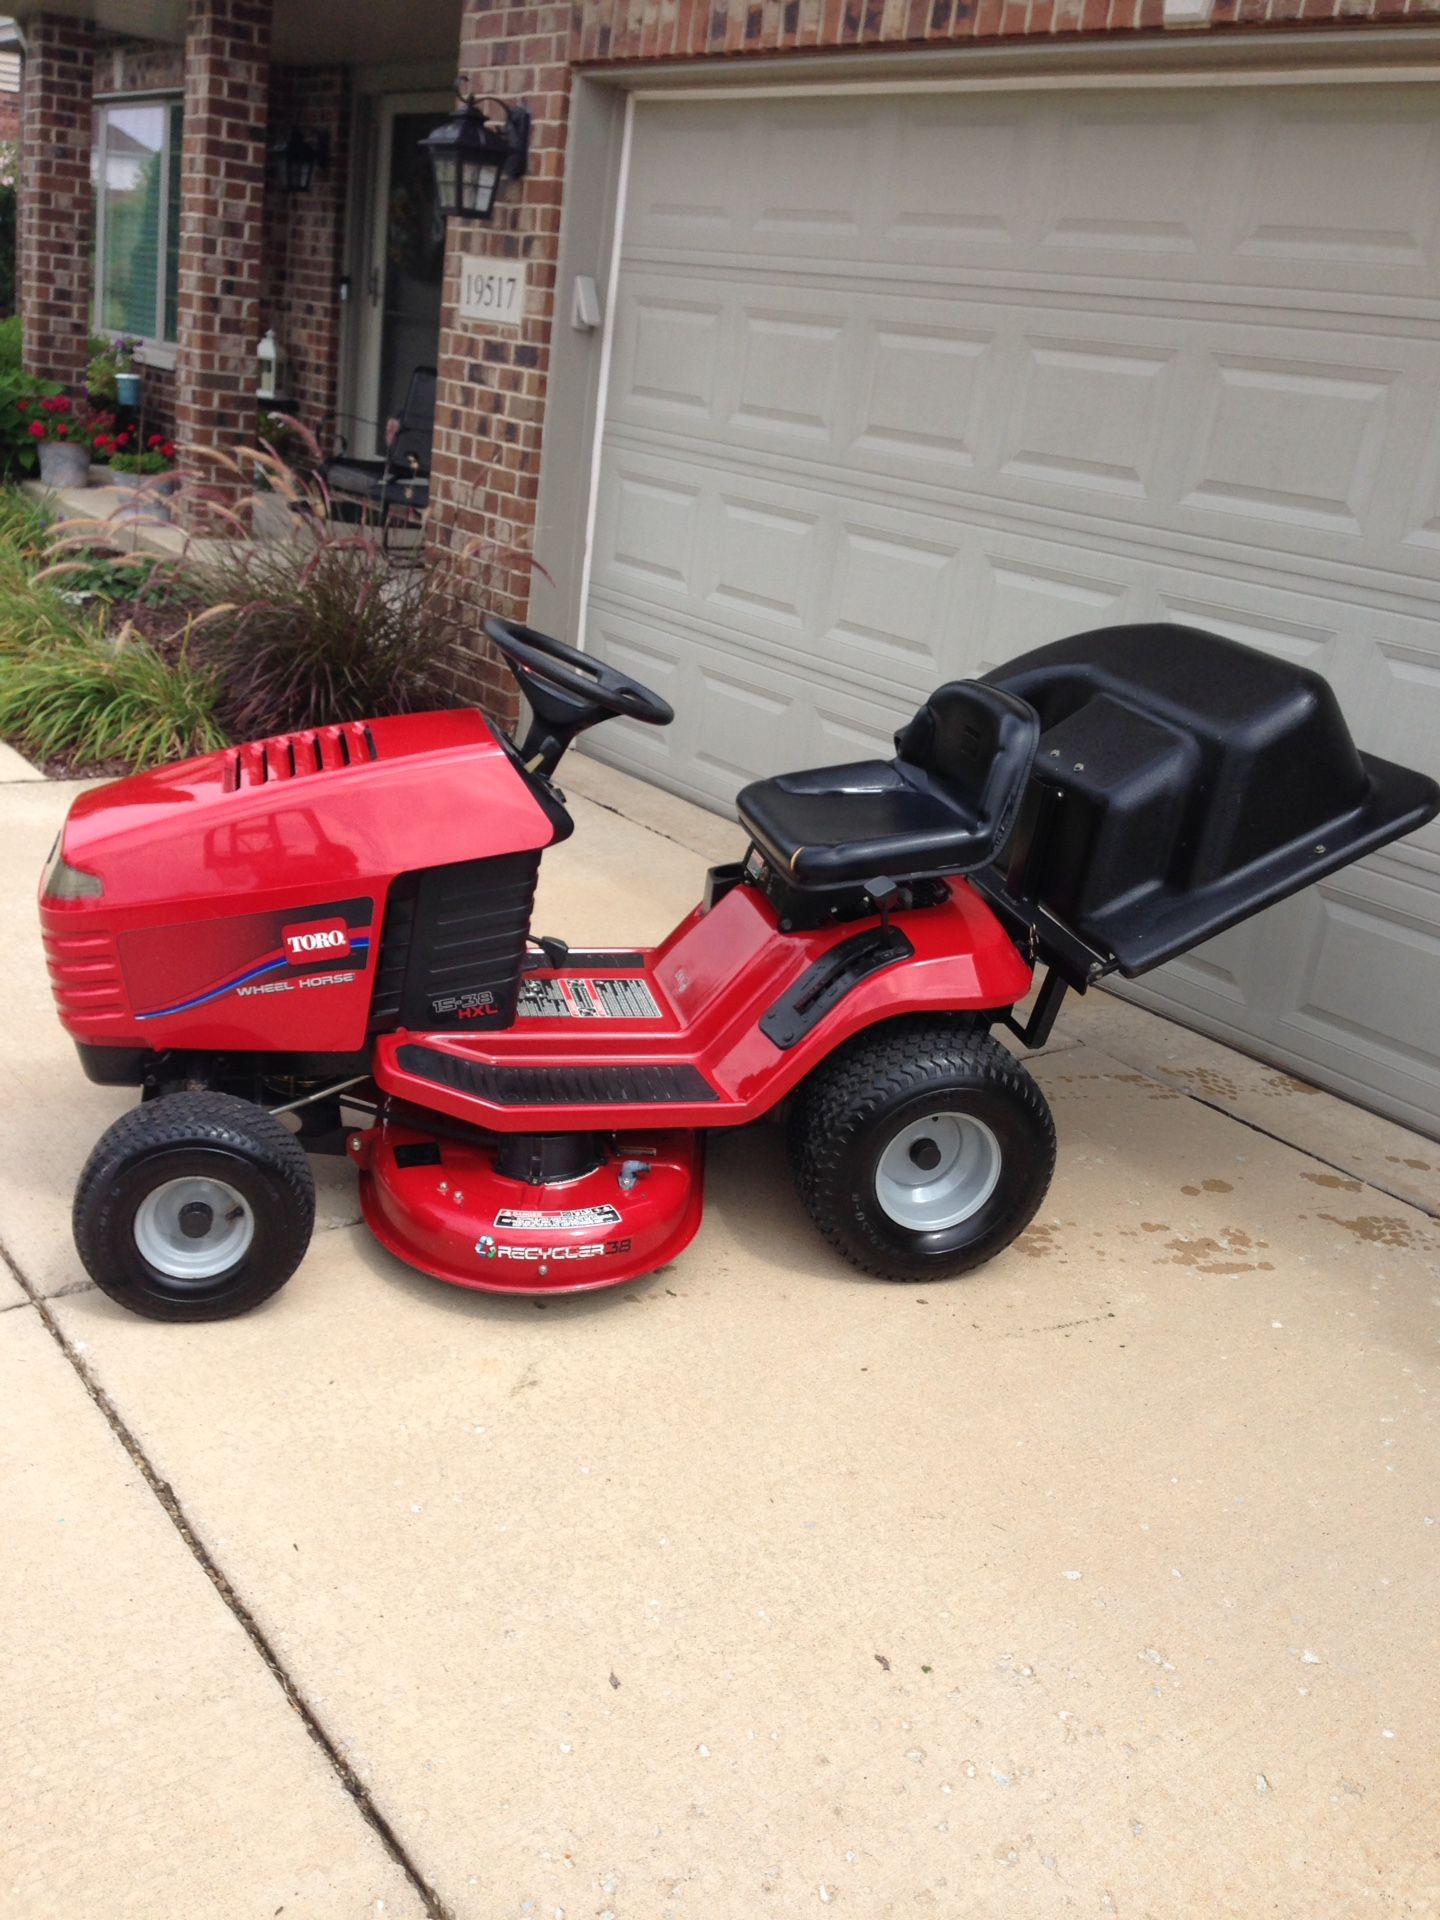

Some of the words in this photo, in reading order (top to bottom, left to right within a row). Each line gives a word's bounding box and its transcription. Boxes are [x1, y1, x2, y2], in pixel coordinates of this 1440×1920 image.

[466, 274, 517, 310] 19517
[287, 929, 346, 953] TORO
[236, 982, 295, 996] WHEEL
[299, 972, 355, 989] HORSE
[432, 991, 494, 1013] 15-38
[458, 1004, 499, 1019] HXL
[497, 1243, 605, 1260] RECYCLER
